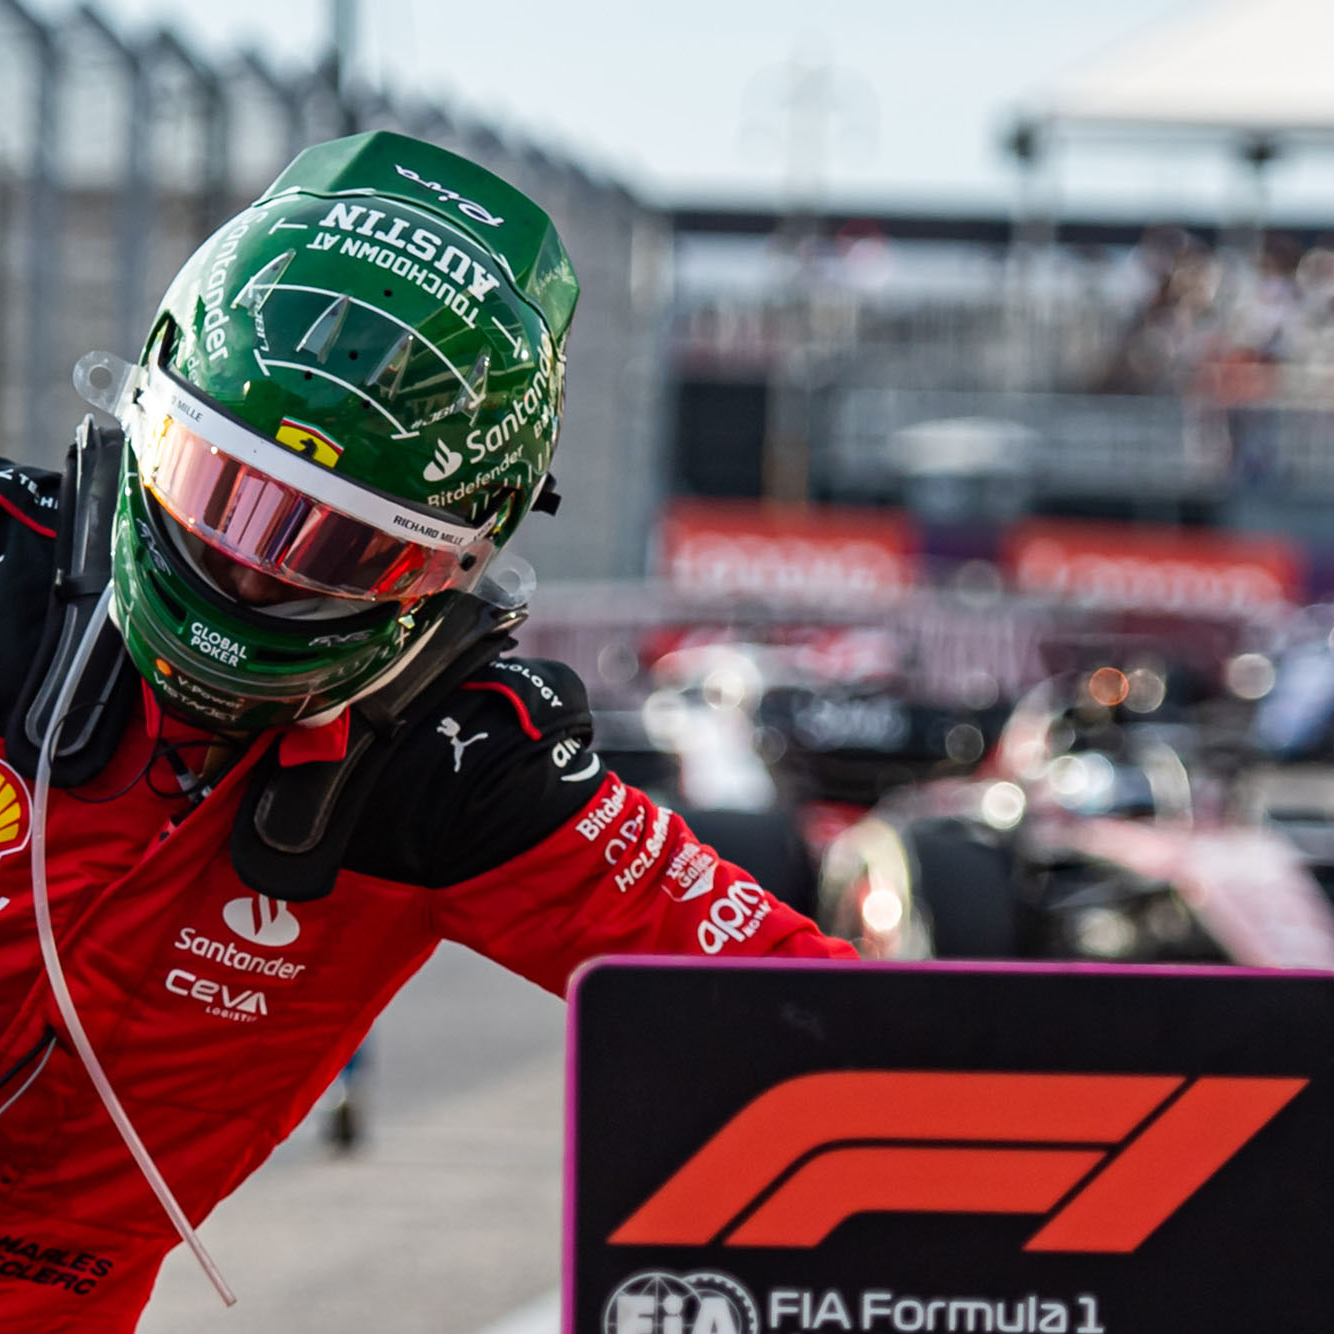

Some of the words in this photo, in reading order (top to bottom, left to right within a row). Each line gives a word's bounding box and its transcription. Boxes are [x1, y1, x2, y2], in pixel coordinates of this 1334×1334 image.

[306, 231, 341, 251] AT
[318, 201, 502, 303] AUSTIN
[339, 237, 481, 330] TOUCHDOWN
[392, 514, 440, 538] RICHARD
[190, 621, 247, 660] GLOBAL
[190, 636, 239, 668] POKER
[174, 927, 307, 980] Santander
[769, 1291, 851, 1331] FIA
[862, 1292, 1067, 1334] Formula
[1078, 1296, 1105, 1334] 1
